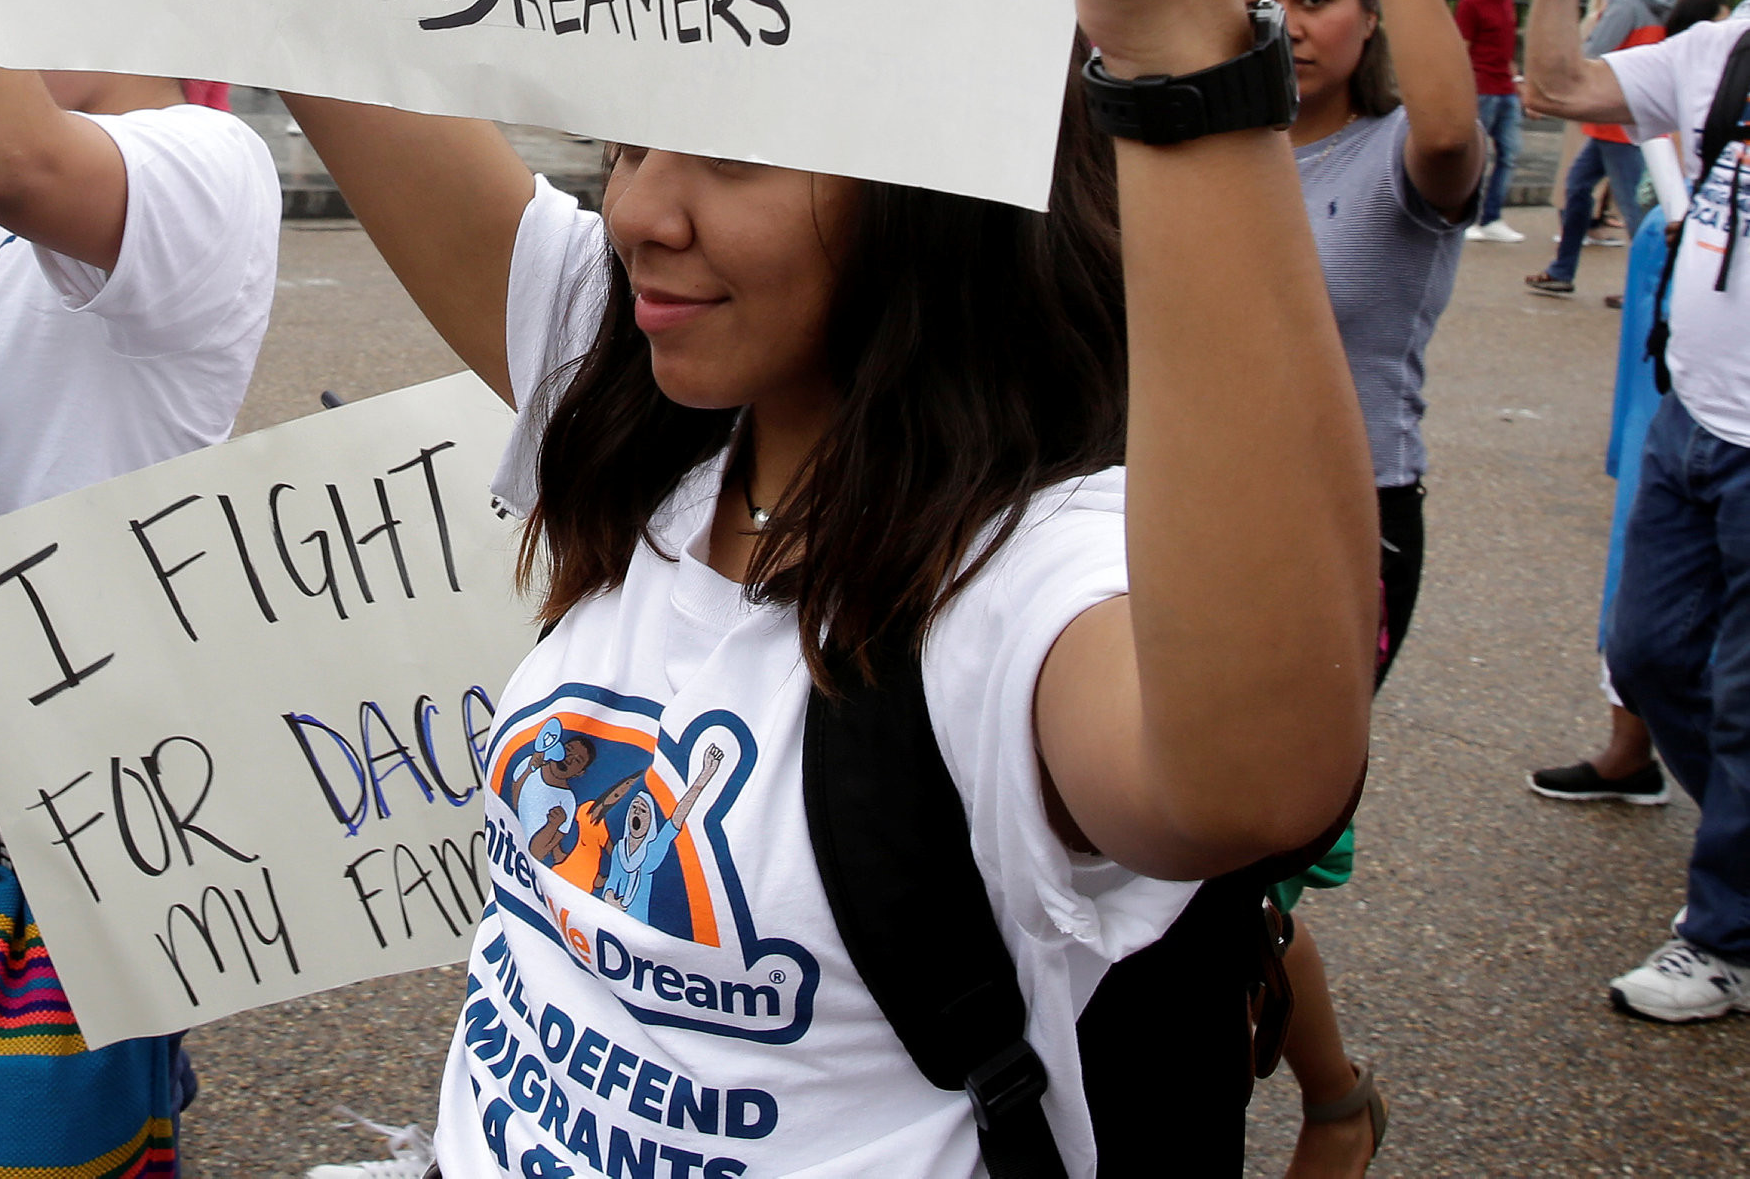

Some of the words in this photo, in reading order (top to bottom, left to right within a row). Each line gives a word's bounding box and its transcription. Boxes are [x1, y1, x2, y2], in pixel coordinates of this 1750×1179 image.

[129, 441, 462, 643] FIGHT
[25, 735, 260, 904] FOR
[539, 1002, 778, 1140] DEFEND
